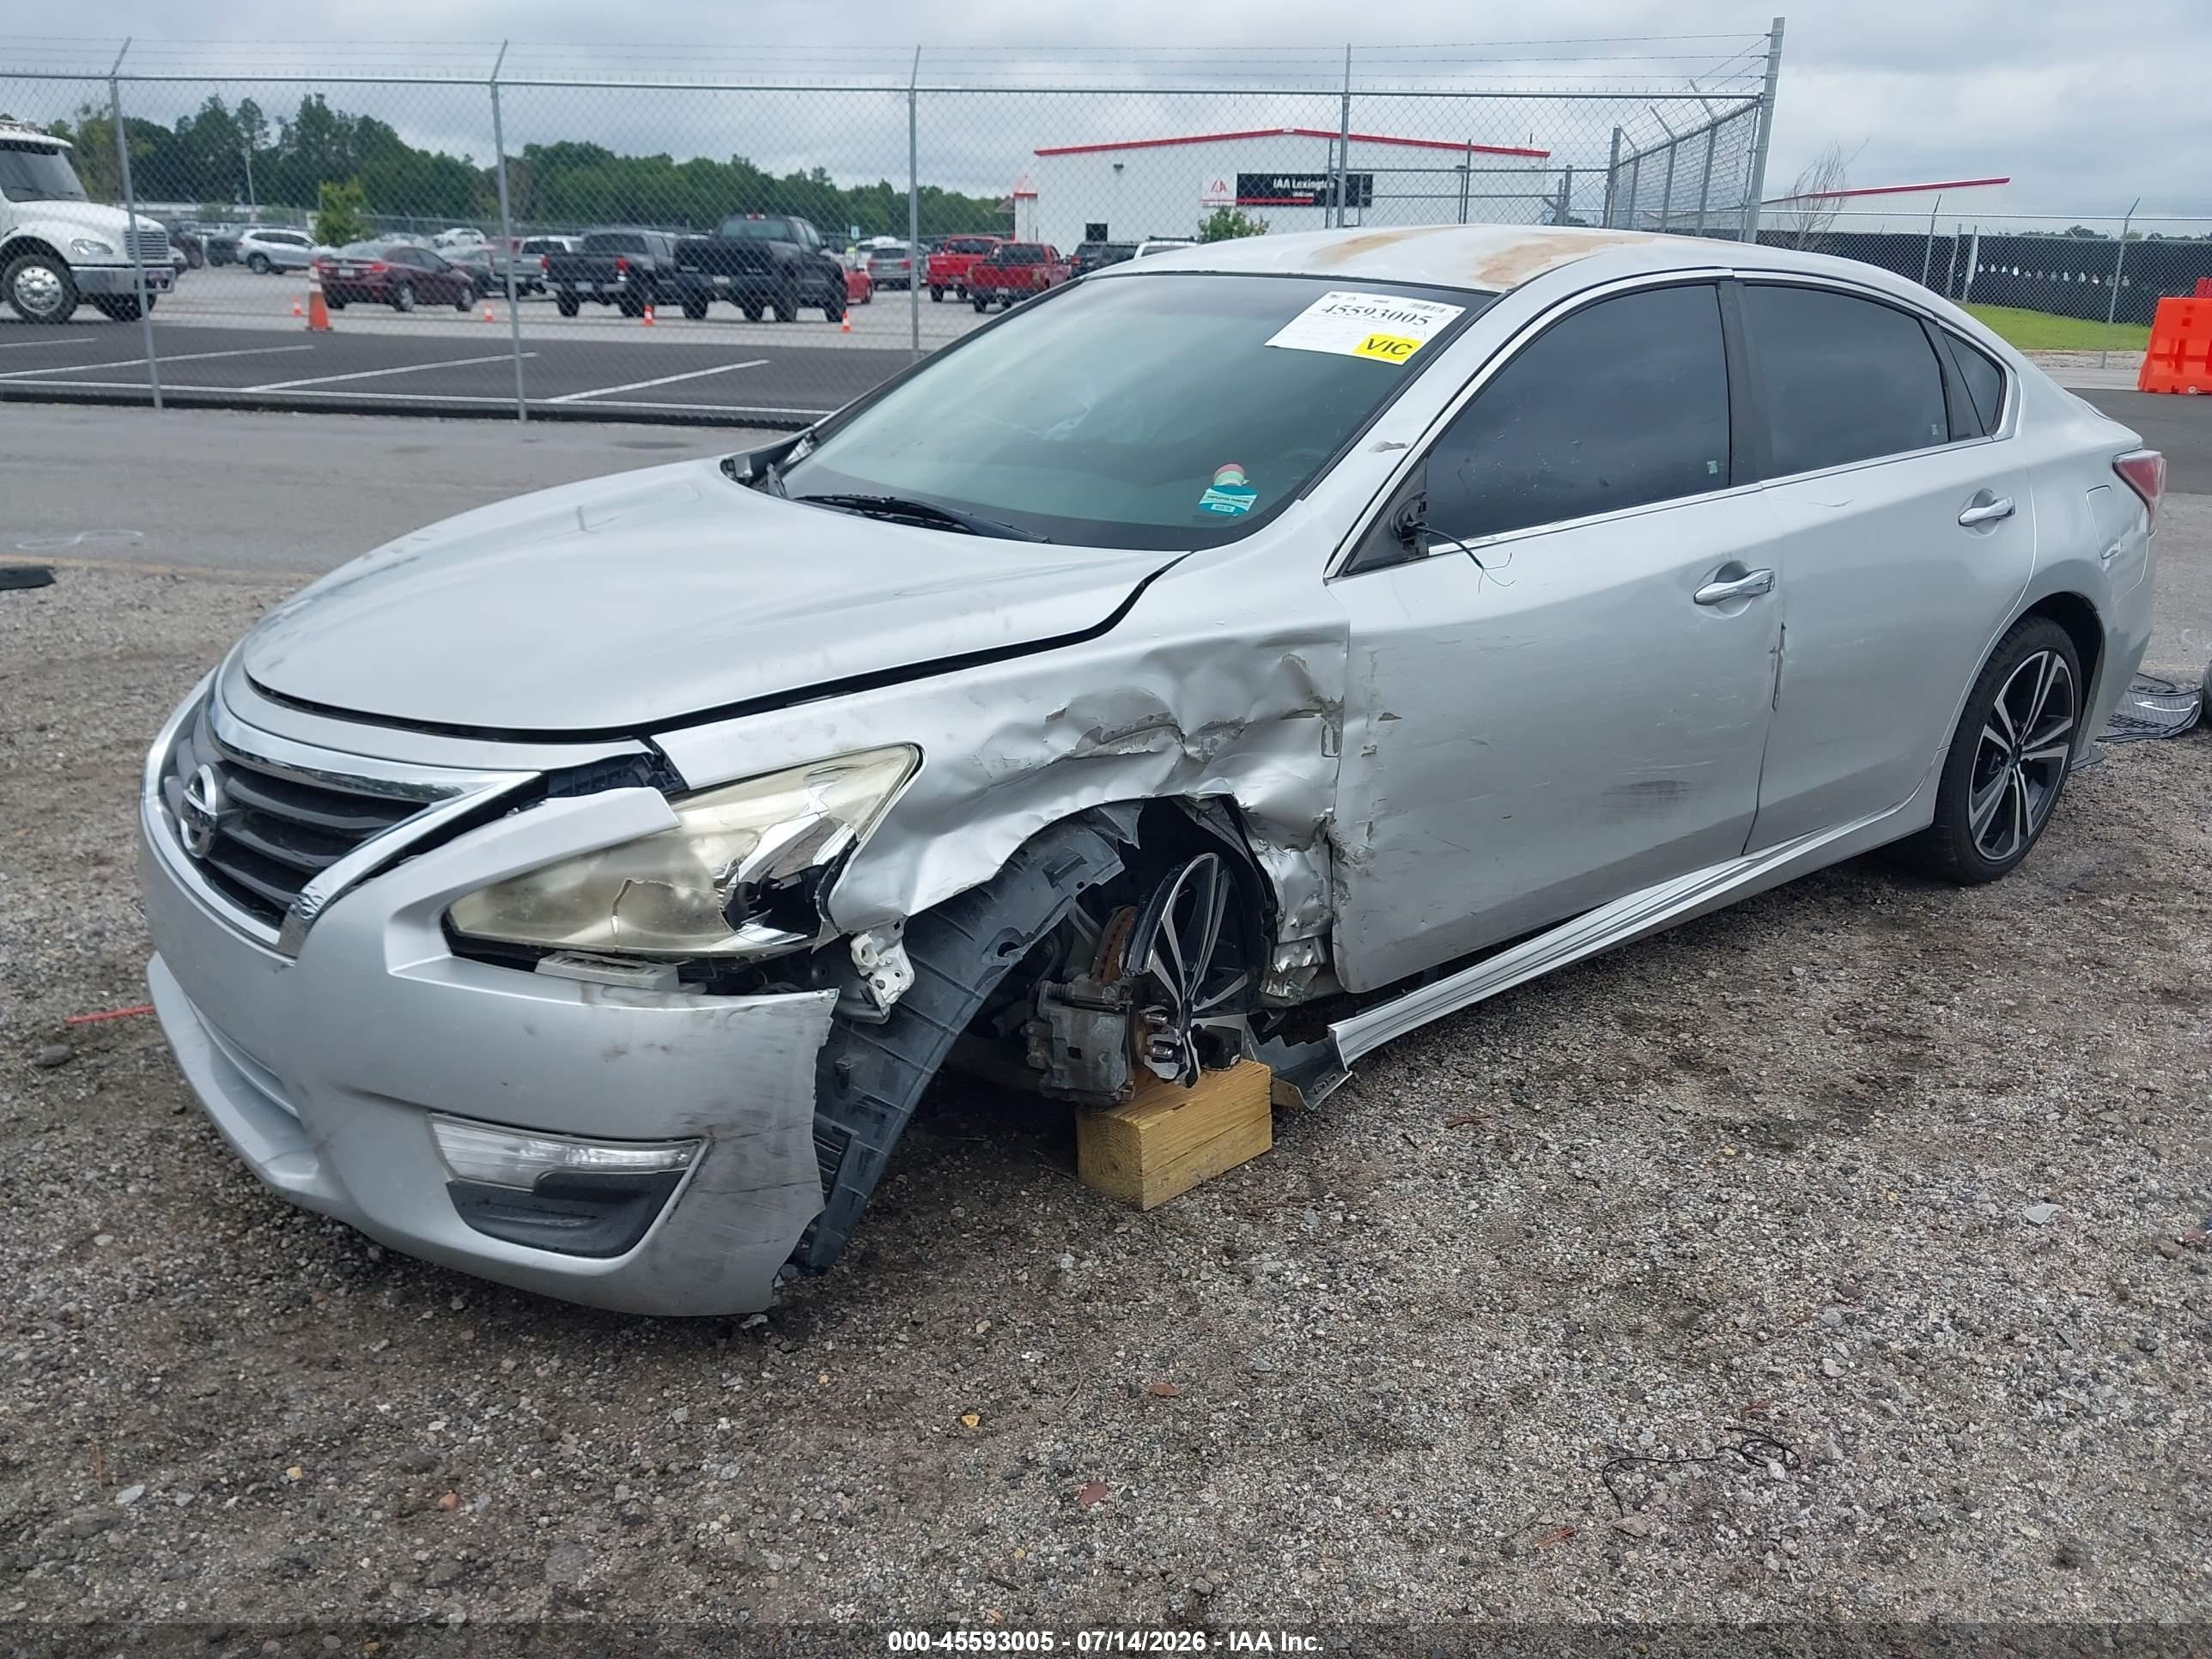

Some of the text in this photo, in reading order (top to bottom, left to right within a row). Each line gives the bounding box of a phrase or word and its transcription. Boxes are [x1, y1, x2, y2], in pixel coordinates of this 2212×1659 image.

[1273, 178, 1291, 189] IAA
[1321, 303, 1433, 326] 45593005
[1366, 337, 1413, 356] VIC
